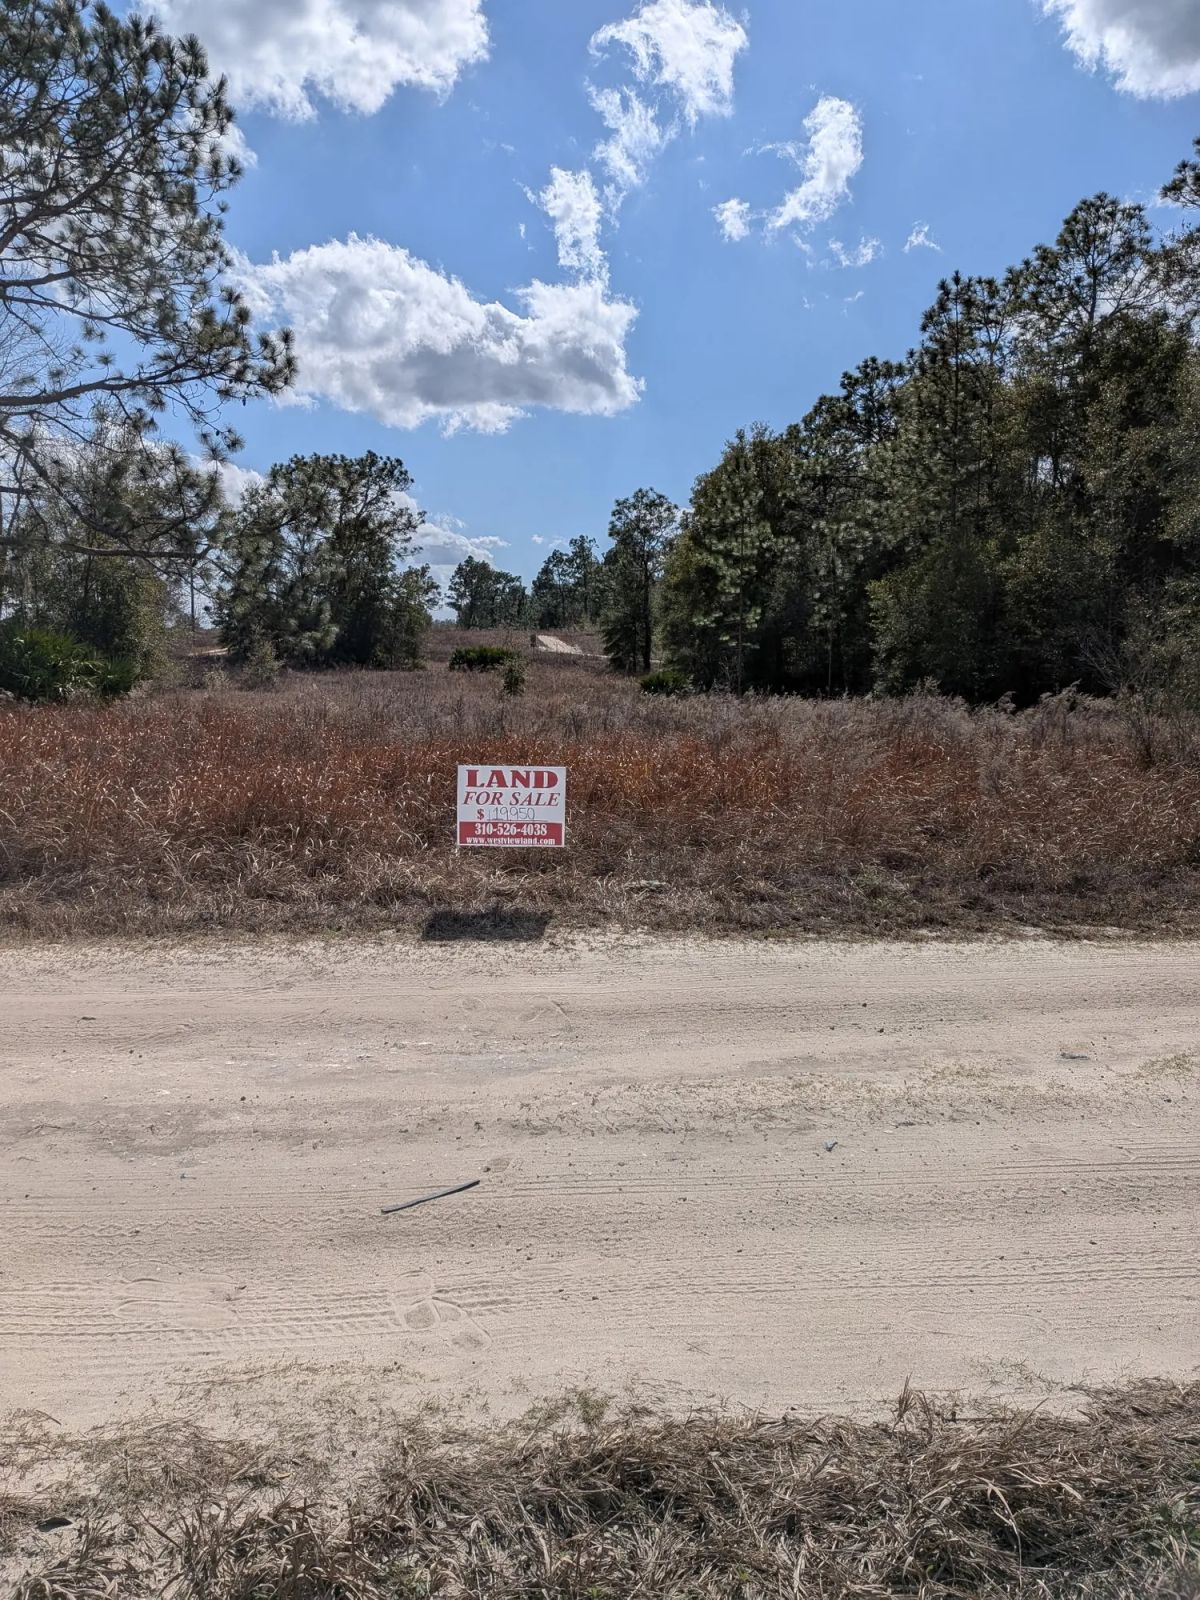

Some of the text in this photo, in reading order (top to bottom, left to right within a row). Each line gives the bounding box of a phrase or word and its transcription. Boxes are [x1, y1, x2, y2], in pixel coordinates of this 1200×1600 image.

[465, 769, 558, 789] LAND
[463, 791, 561, 807] FOR SALE
[474, 823, 548, 836] 310-526-4038
[466, 837, 556, 845] www.westviewland.com
